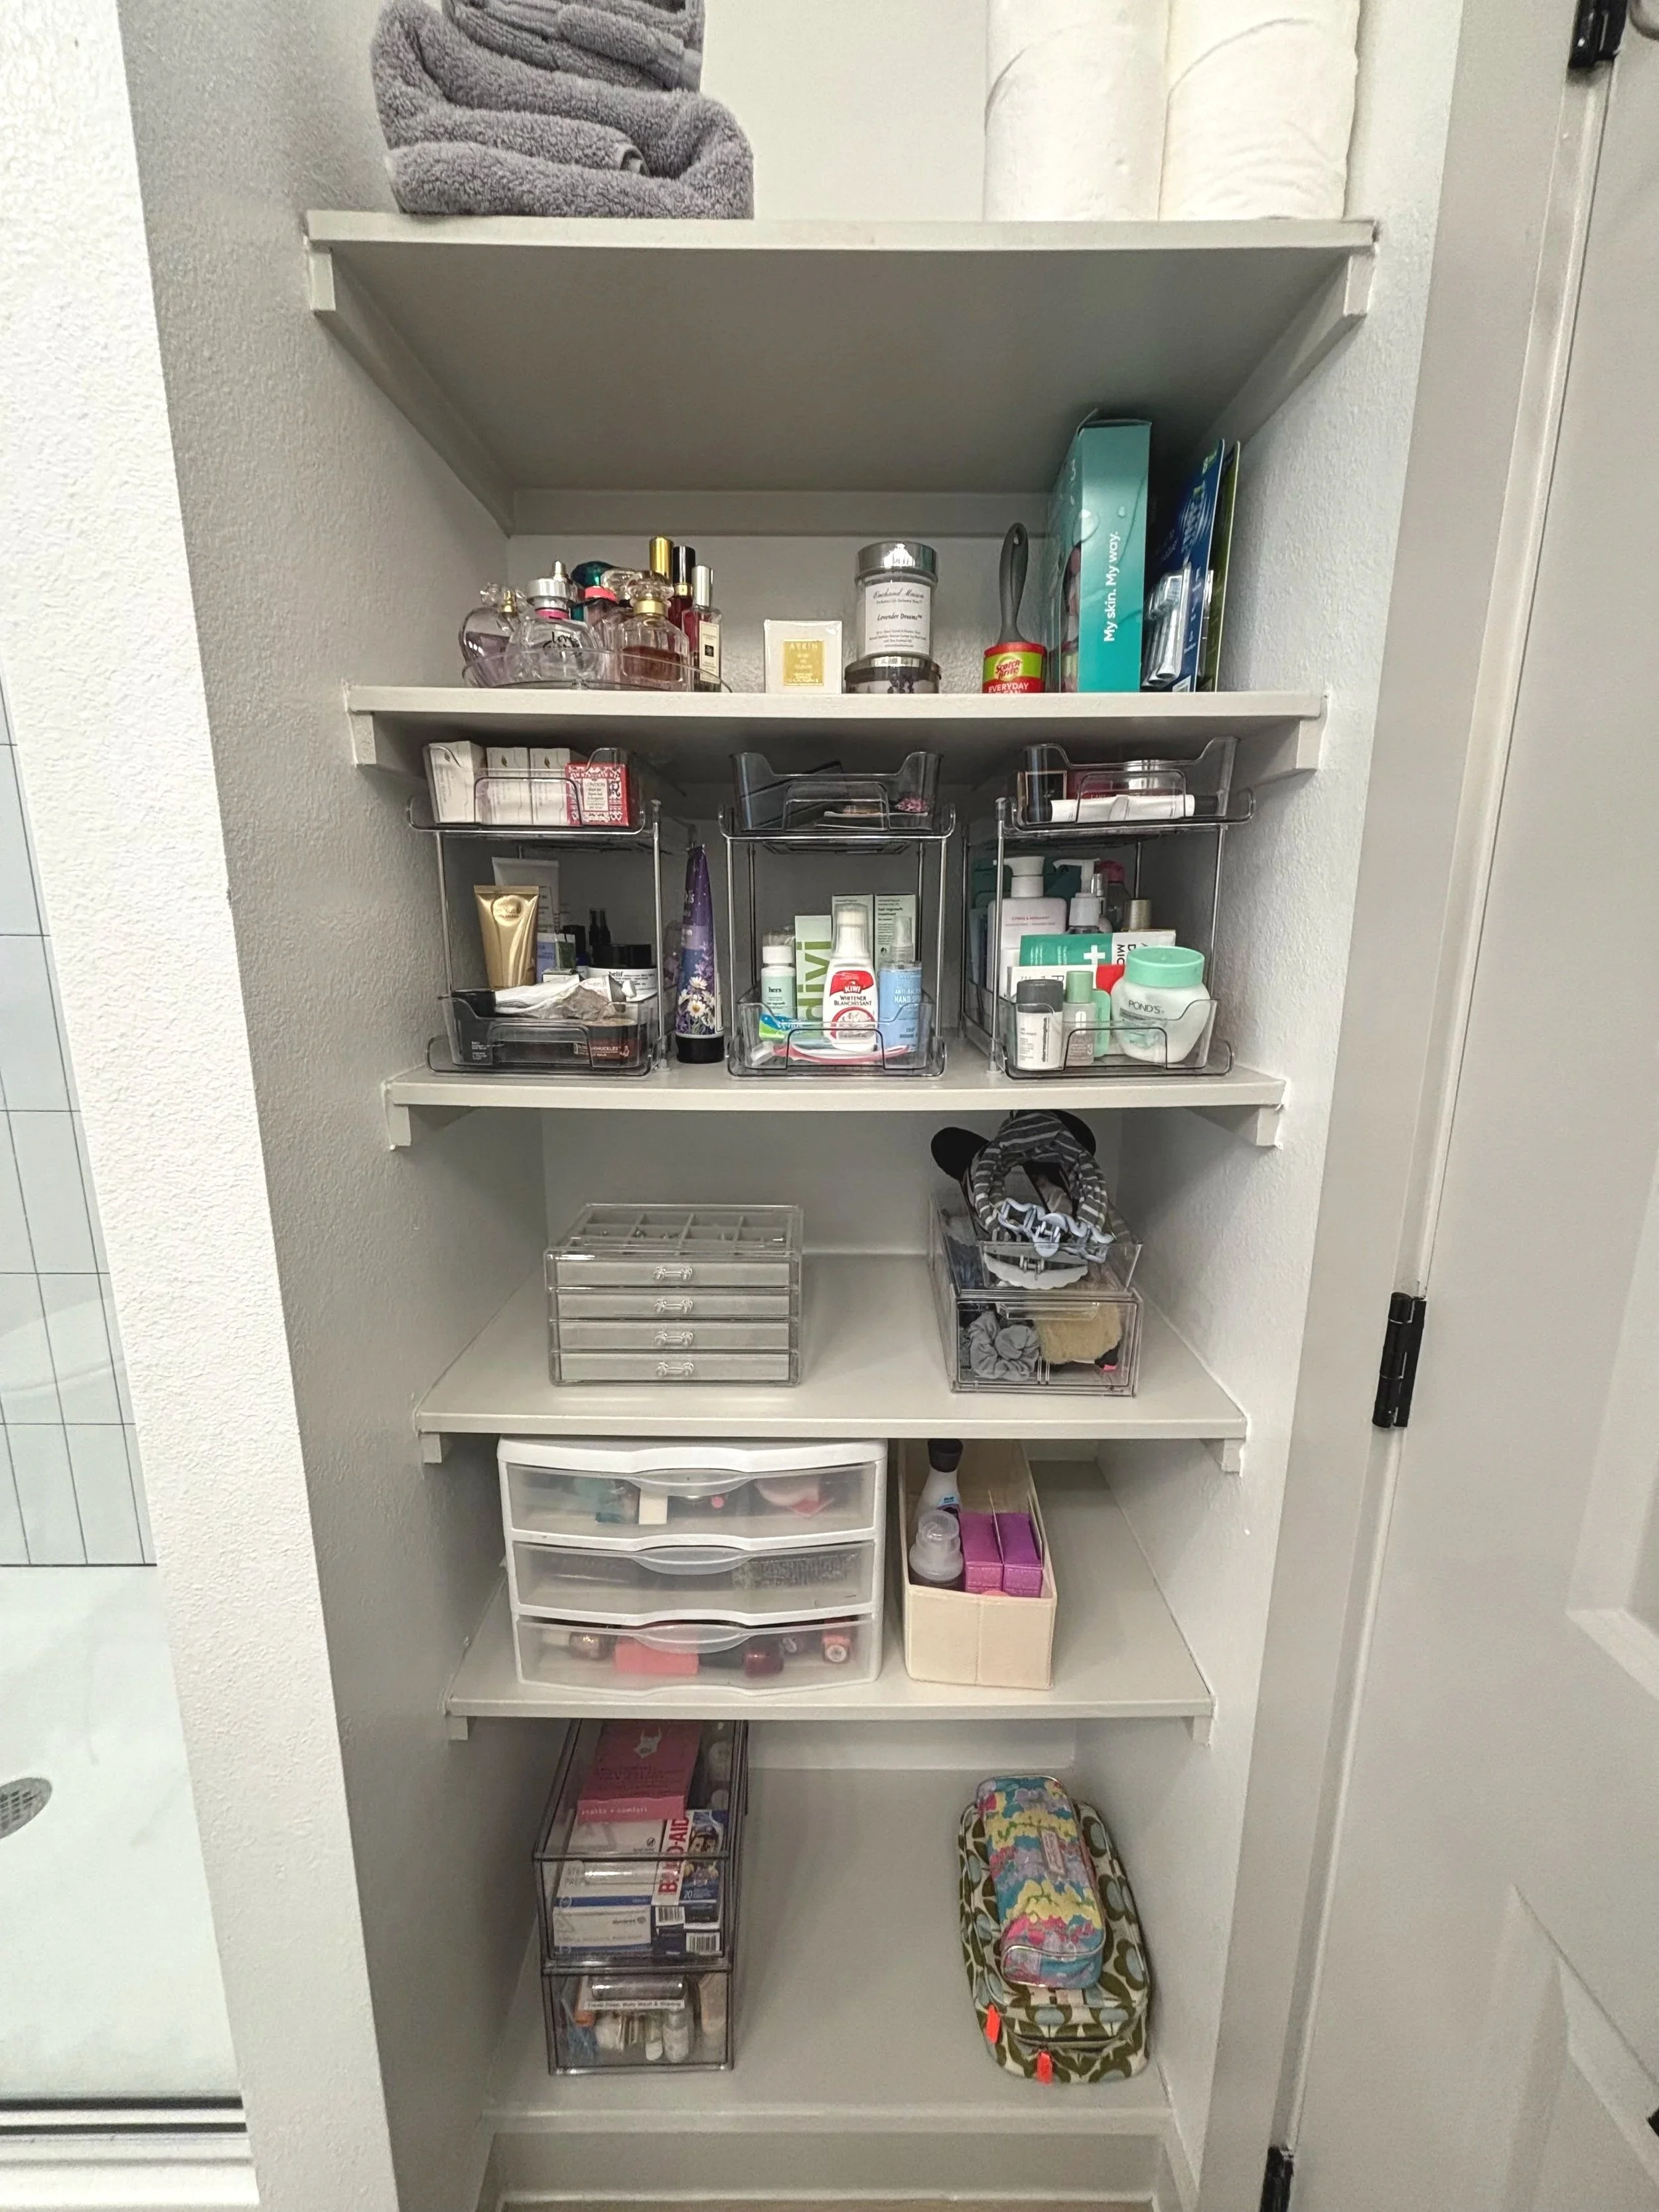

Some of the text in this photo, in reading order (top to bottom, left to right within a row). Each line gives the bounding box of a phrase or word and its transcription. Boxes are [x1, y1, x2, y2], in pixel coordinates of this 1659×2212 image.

[1104, 531, 1121, 642] My skin. My way.
[988, 682, 1029, 693] EVERYDAY
[1129, 999, 1161, 1015] POND'S
